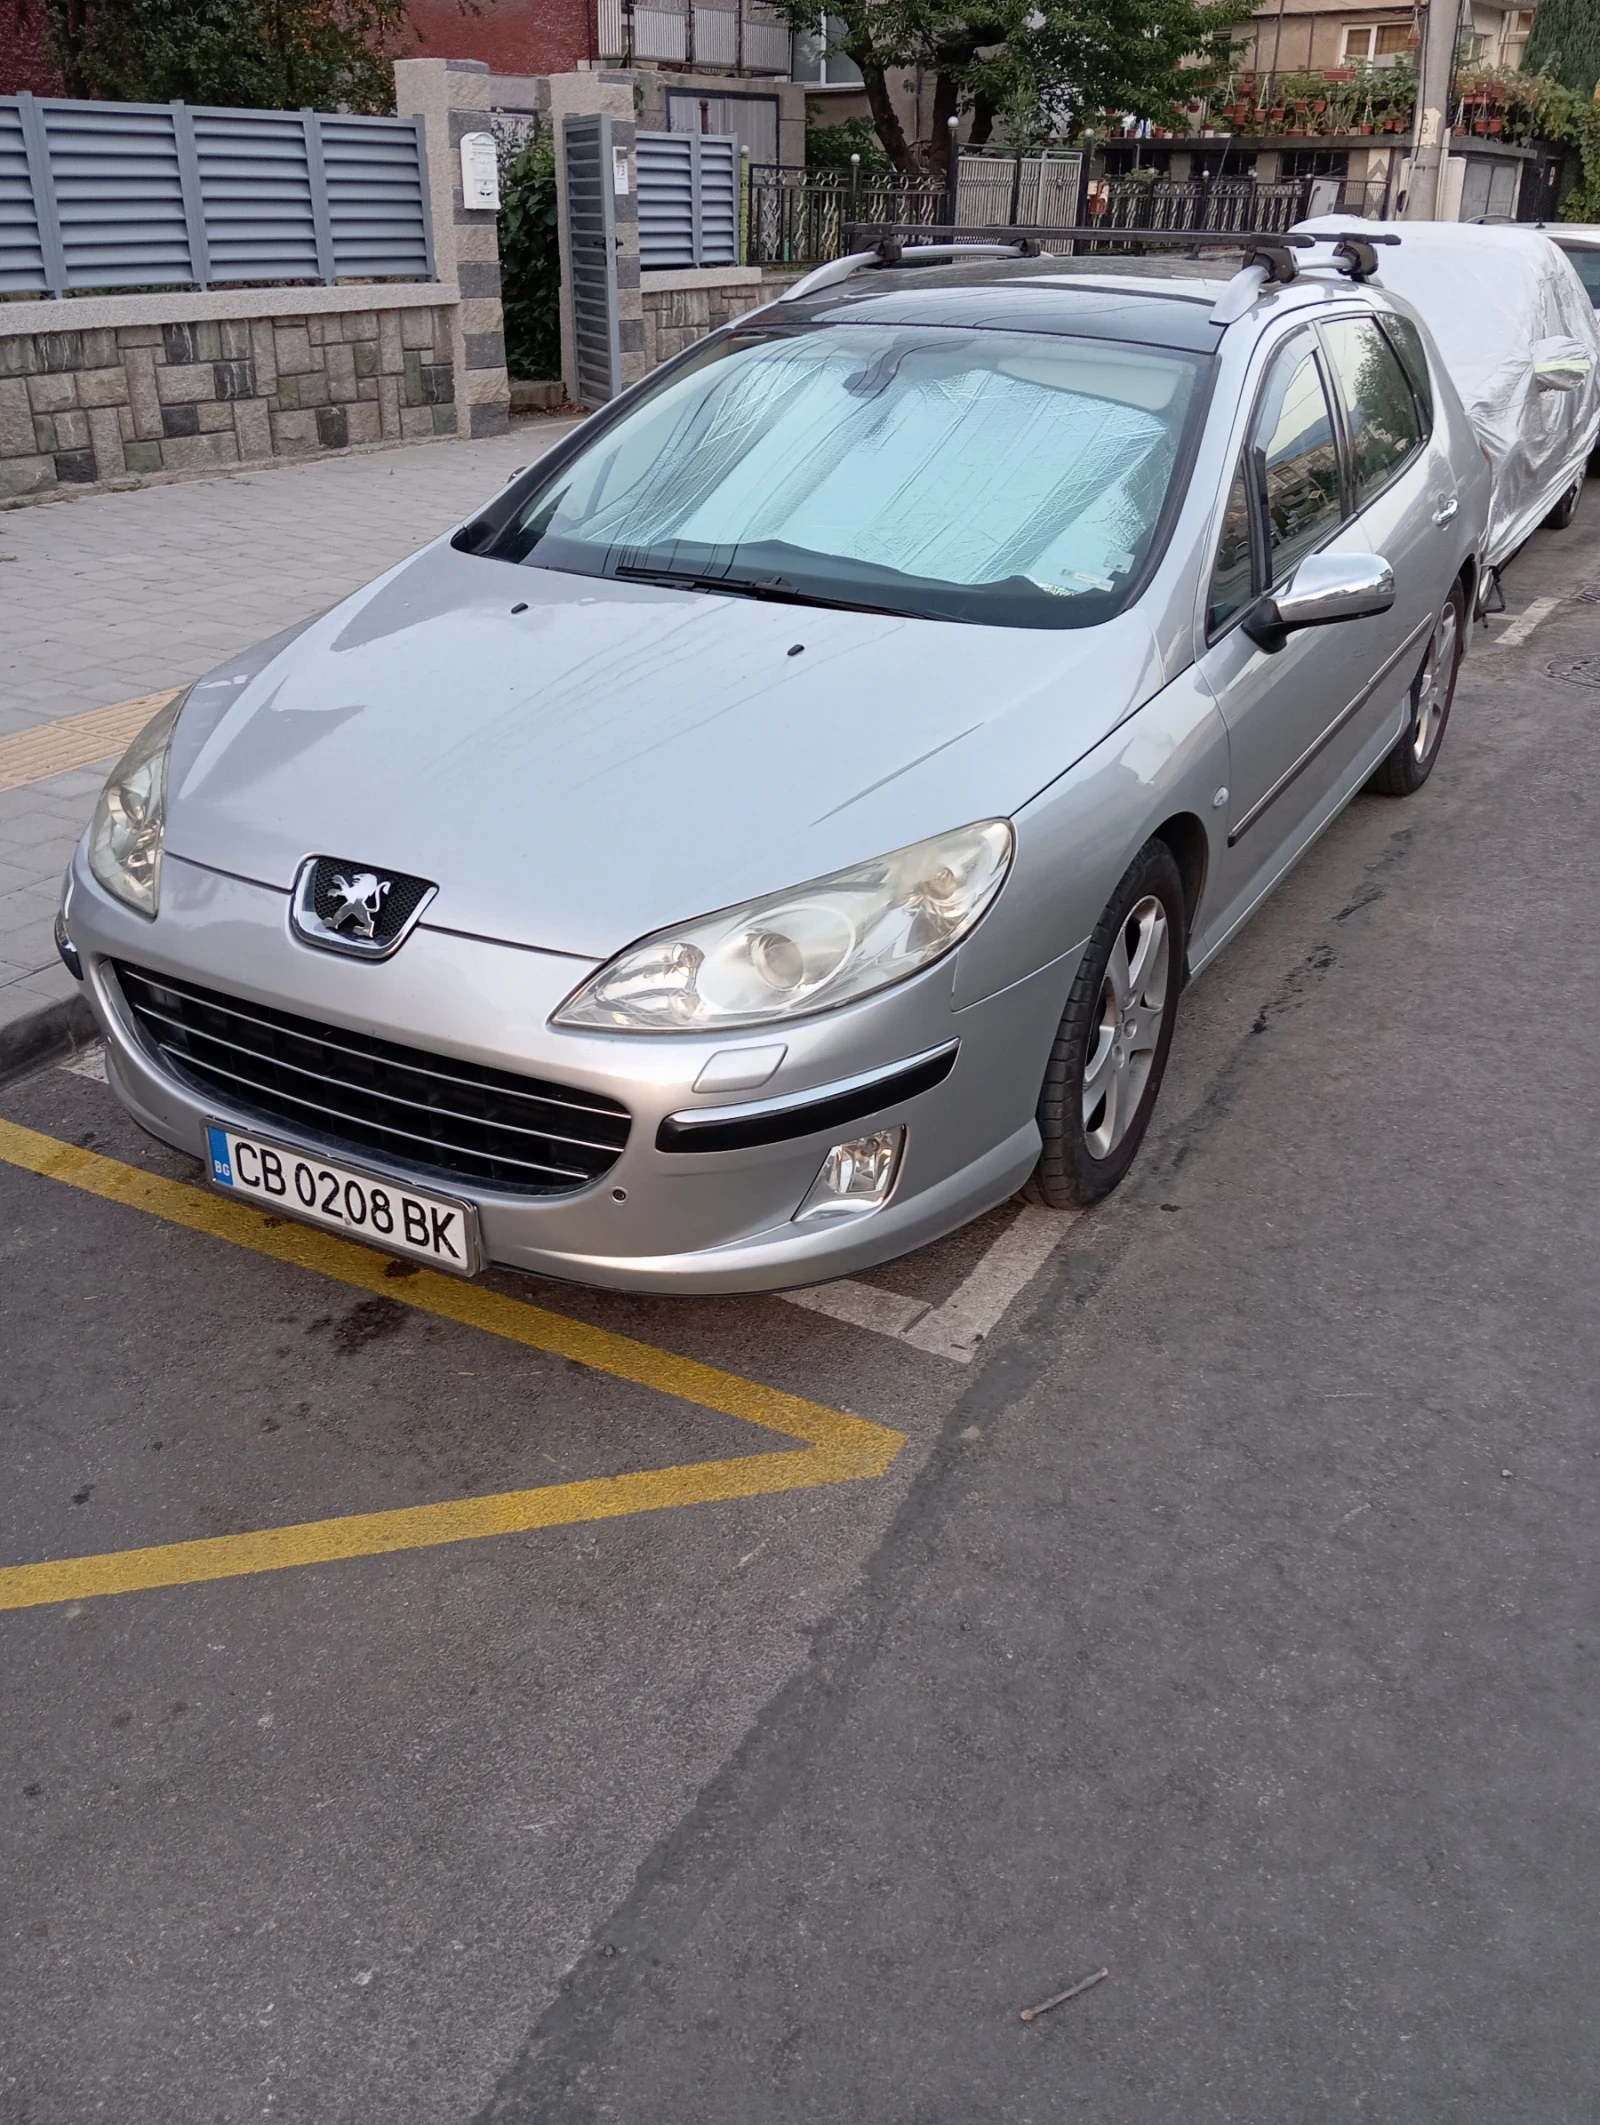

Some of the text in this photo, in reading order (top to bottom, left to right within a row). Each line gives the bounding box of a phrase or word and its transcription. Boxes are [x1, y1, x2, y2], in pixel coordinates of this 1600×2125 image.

[214, 1159, 230, 1177] BG
[234, 1141, 461, 1259] CB 0208 BK
